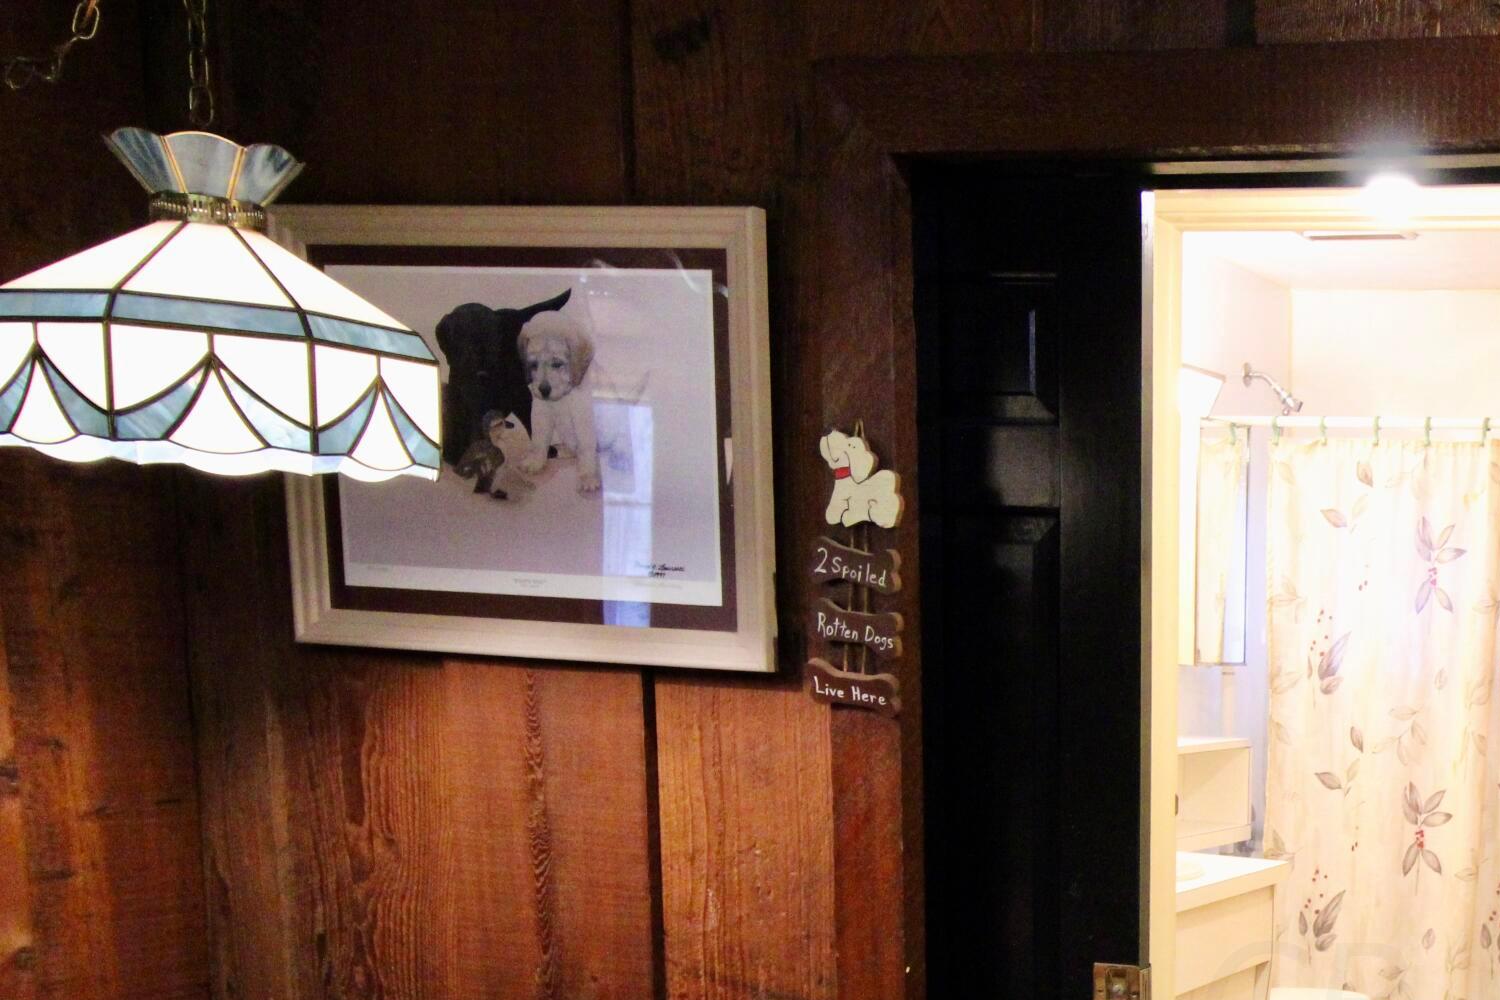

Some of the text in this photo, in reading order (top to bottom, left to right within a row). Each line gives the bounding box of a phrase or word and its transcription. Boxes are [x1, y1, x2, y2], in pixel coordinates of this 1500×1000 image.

[814, 547, 887, 587] 2 Spoiled
[817, 612, 894, 650] Rotten Dogs
[813, 676, 887, 705] Live Here
